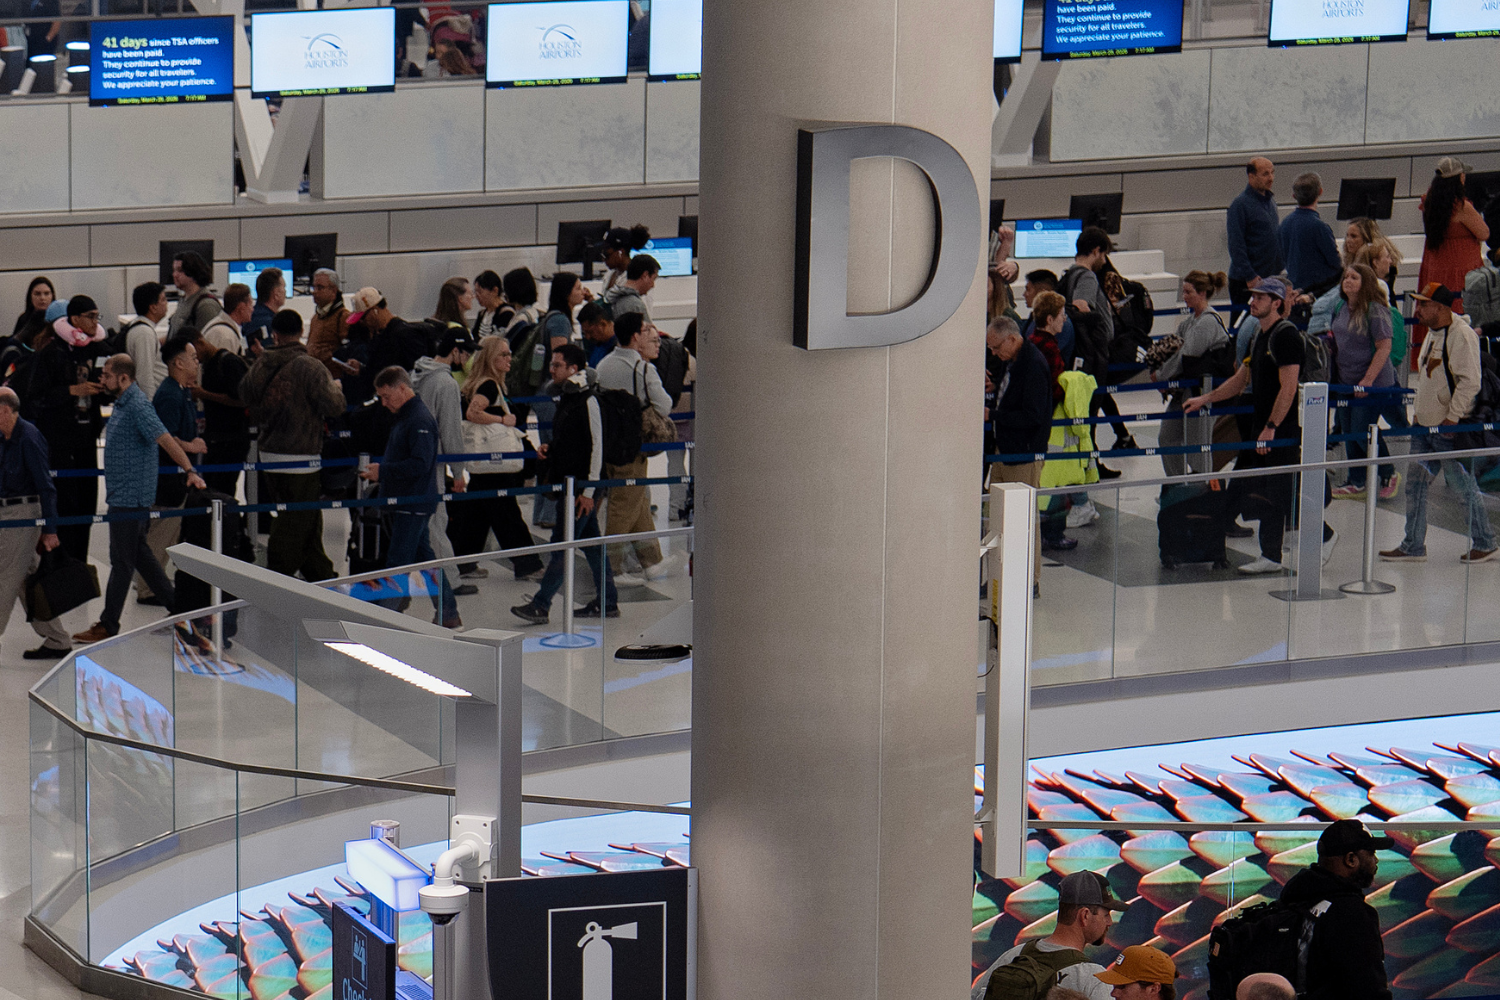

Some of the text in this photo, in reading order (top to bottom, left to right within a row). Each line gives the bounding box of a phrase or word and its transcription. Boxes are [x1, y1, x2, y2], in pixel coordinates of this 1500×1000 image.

[102, 37, 118, 48] 41
[120, 36, 148, 49] days
[794, 123, 980, 351] D
